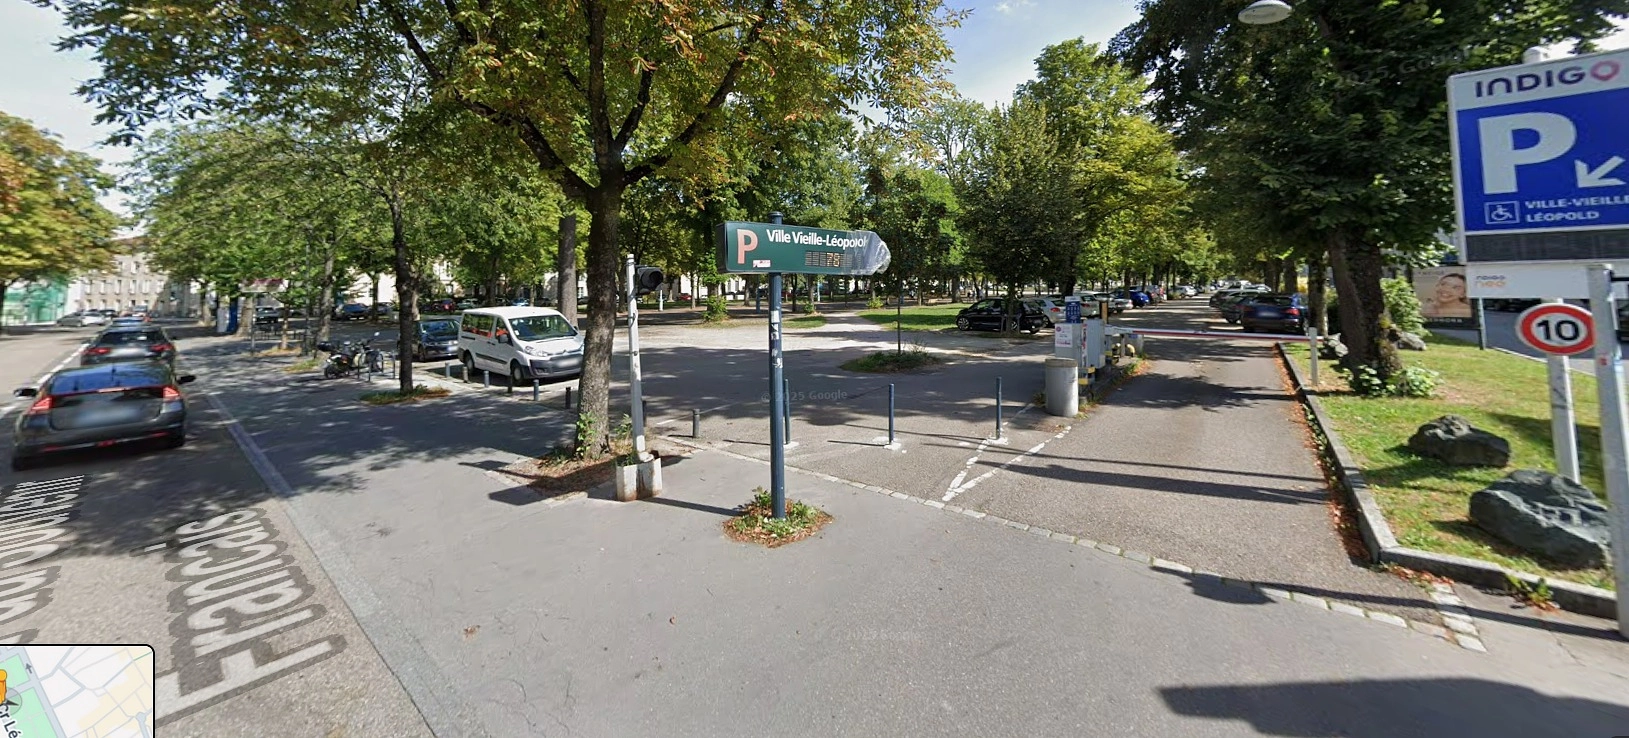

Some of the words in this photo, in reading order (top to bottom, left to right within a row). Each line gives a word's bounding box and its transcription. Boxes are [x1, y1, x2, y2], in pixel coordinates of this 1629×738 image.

[1475, 60, 1620, 98] INDIGO
[1478, 112, 1577, 195] P
[1526, 211, 1600, 223] LÉOPOLD
[737, 229, 758, 264] P
[766, 229, 791, 243] Ville
[1537, 319, 1580, 341] 10
